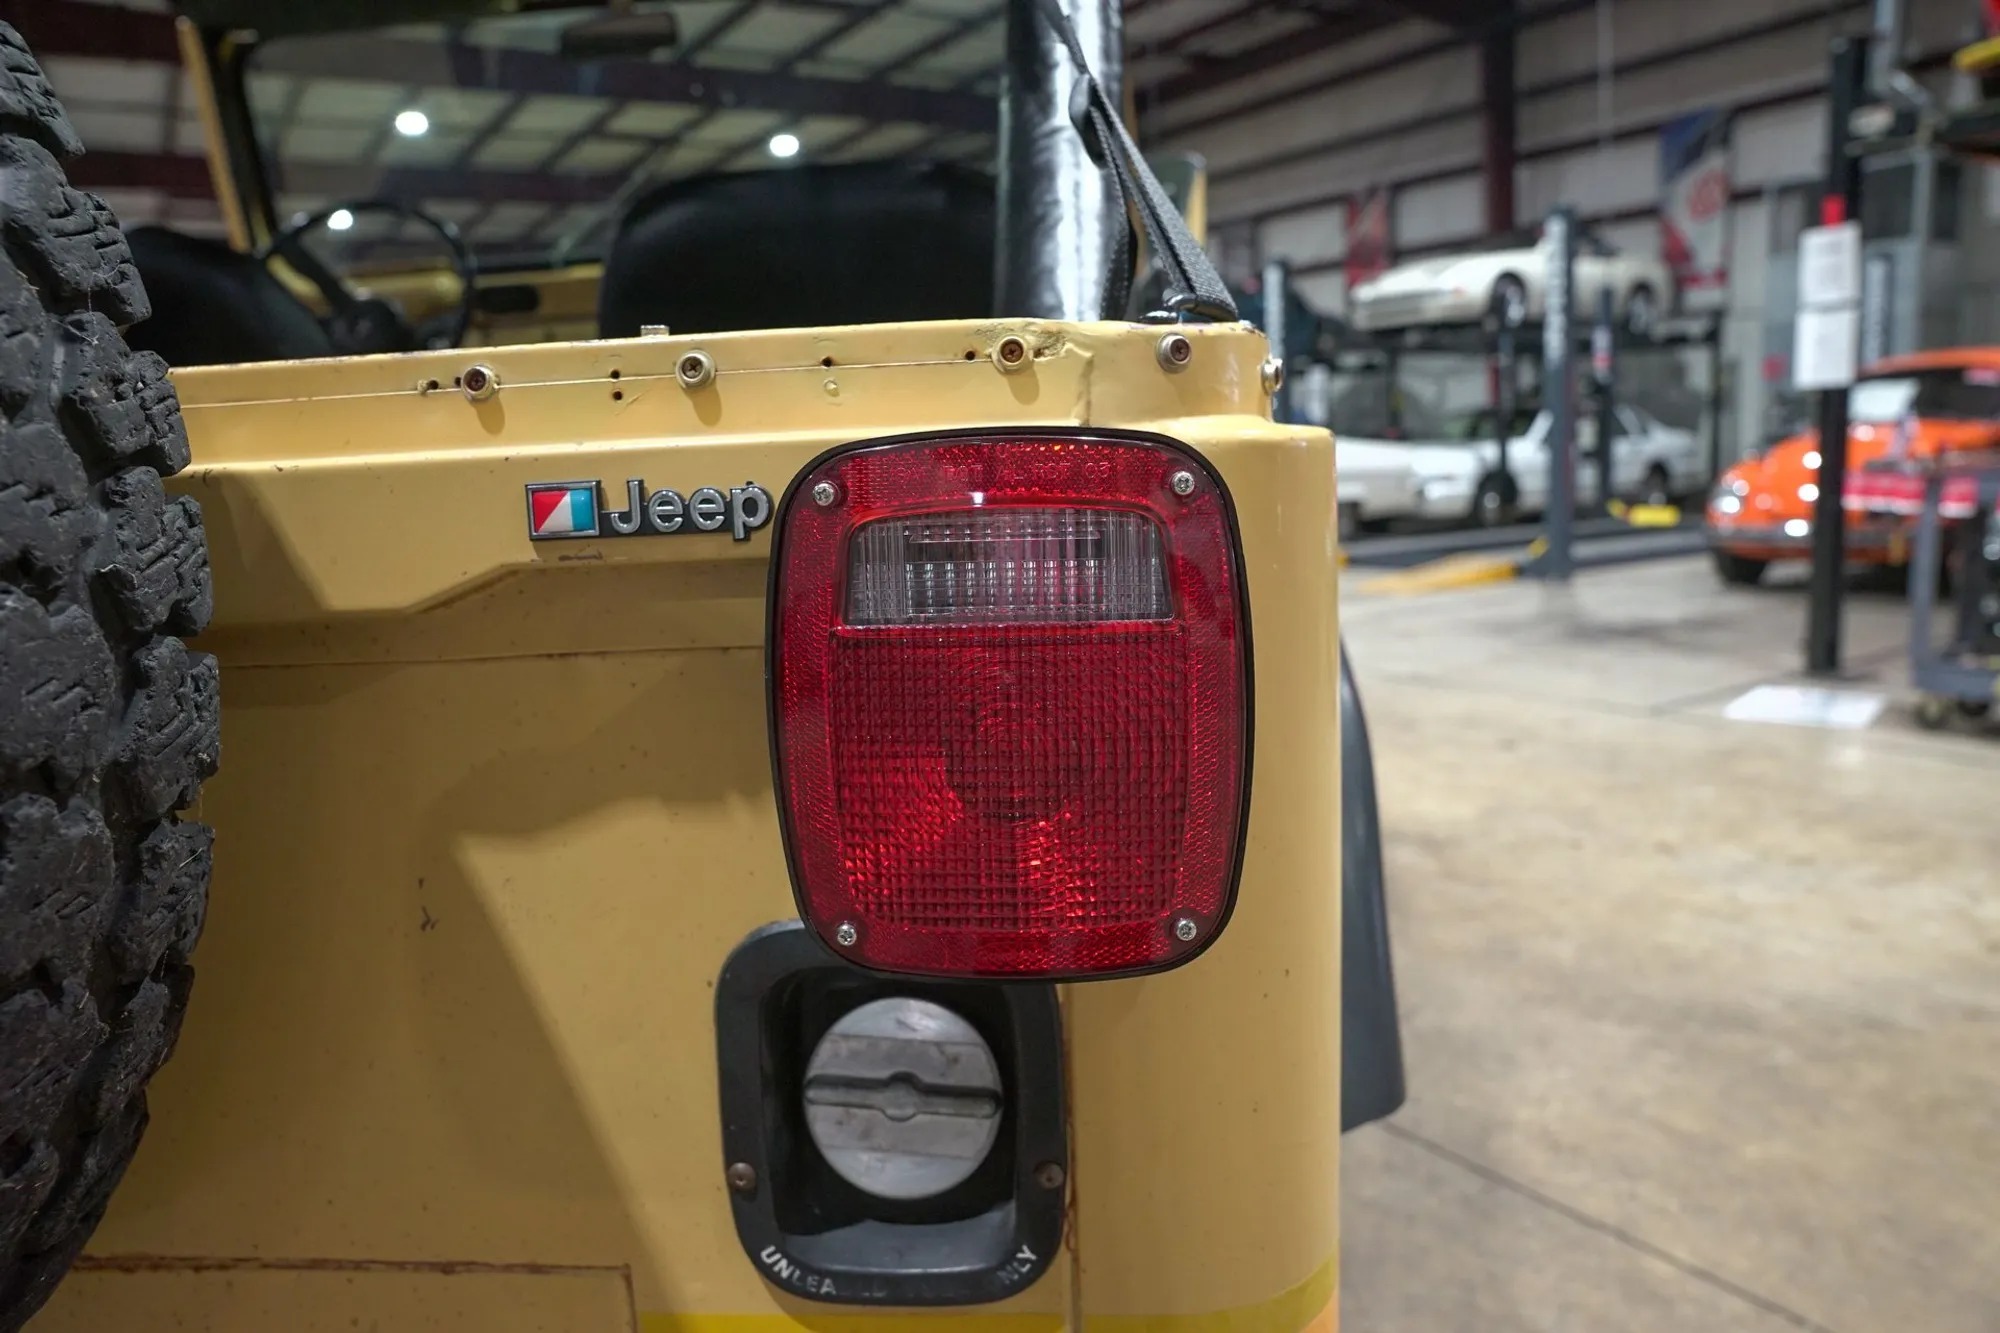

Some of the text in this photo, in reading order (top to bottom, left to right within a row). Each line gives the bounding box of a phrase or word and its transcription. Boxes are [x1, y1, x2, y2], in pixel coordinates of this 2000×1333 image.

[610, 480, 771, 540] Jeep
[760, 1245, 880, 1297] UNLEA
[990, 1243, 1038, 1286] NLY
